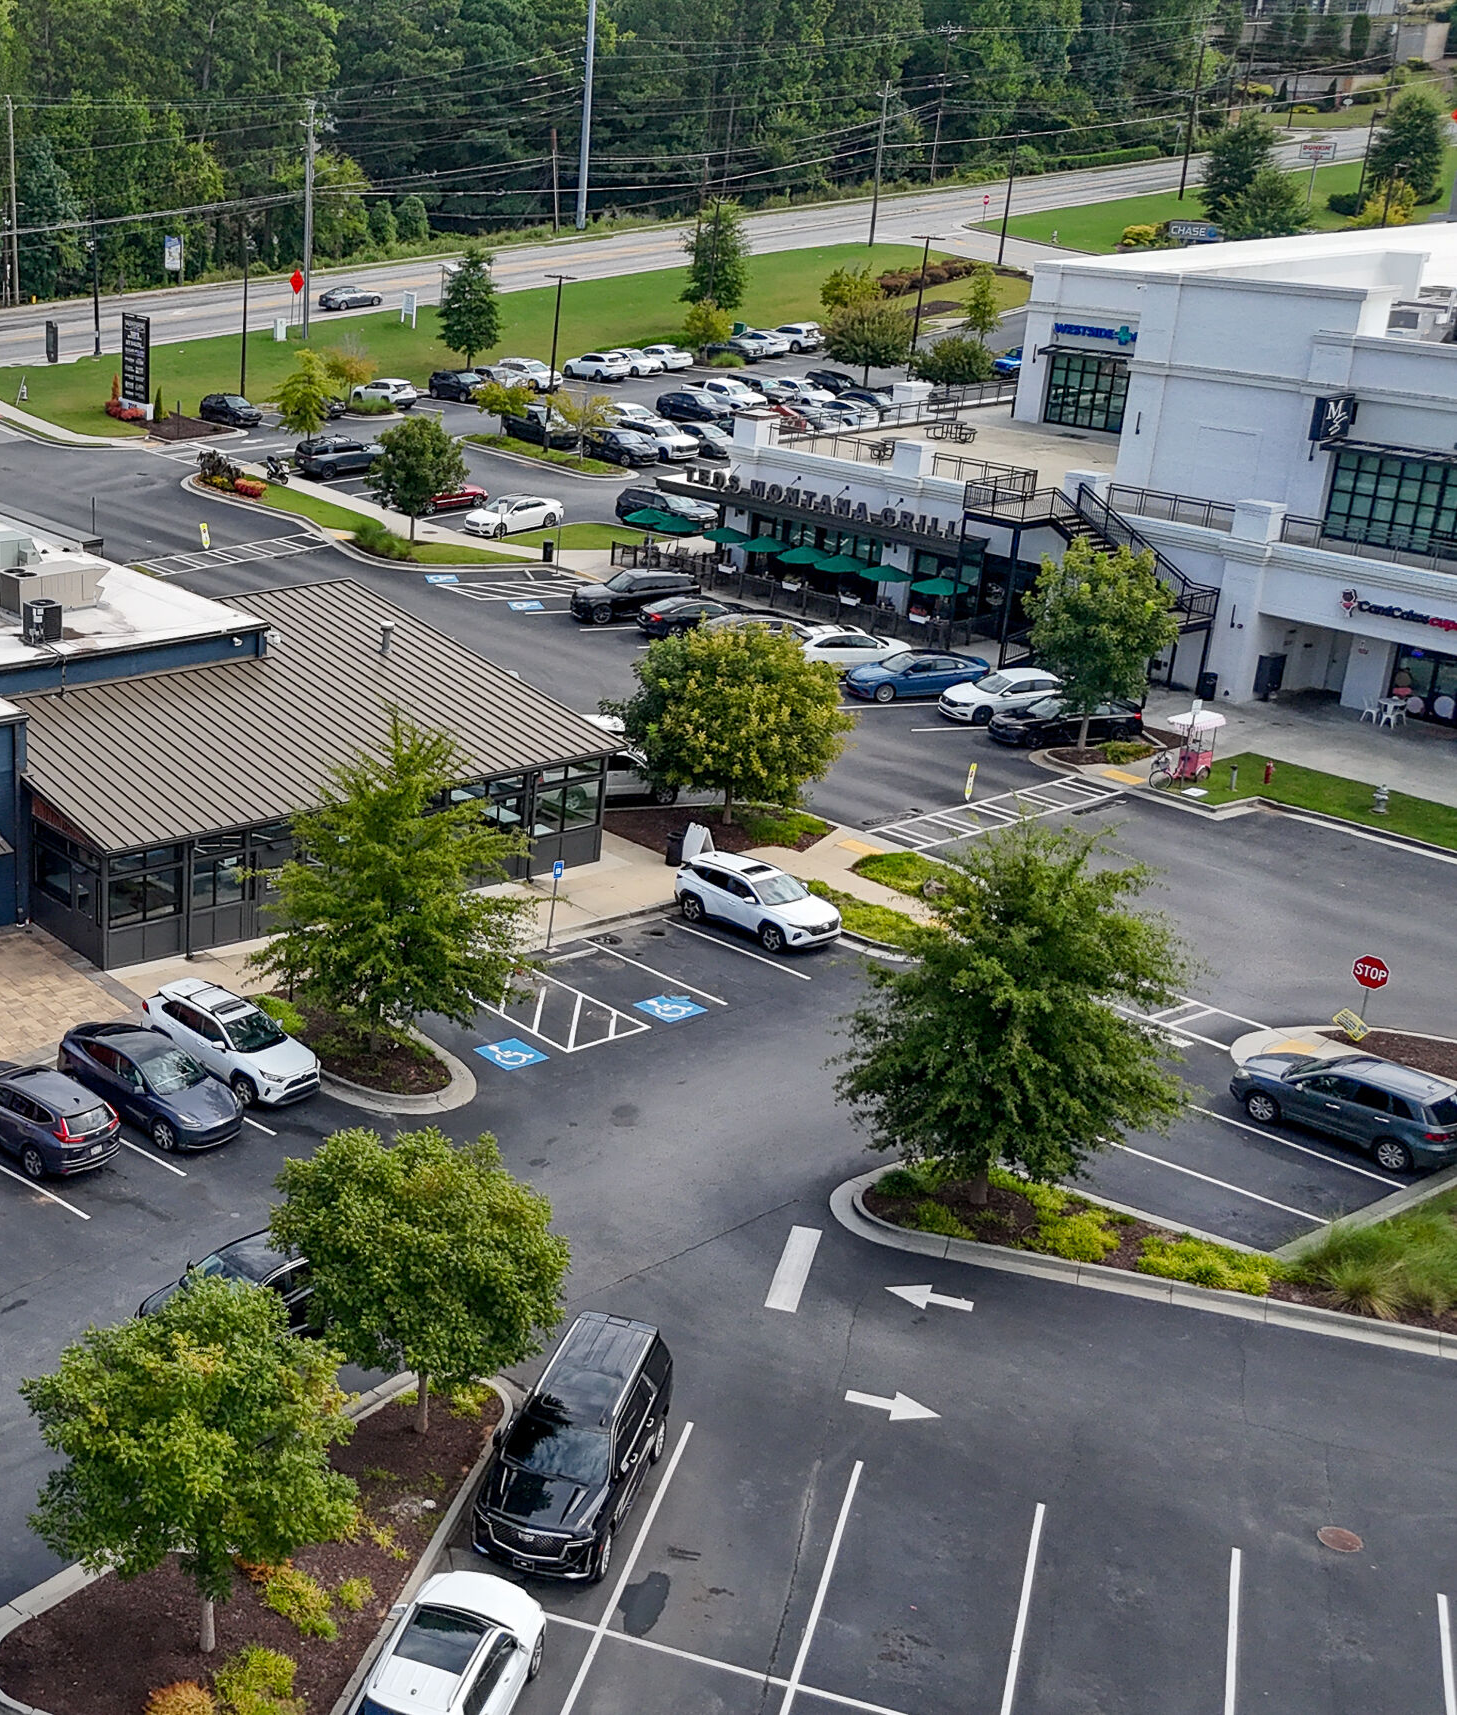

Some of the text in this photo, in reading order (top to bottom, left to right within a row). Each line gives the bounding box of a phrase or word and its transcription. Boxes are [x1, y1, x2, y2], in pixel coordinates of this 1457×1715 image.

[1170, 225, 1206, 238] CHASE
[1054, 322, 1115, 340] WESTSIDE
[749, 479, 871, 524] MONTANA
[879, 506, 961, 540] GRILL
[1354, 962, 1387, 982] STOP
